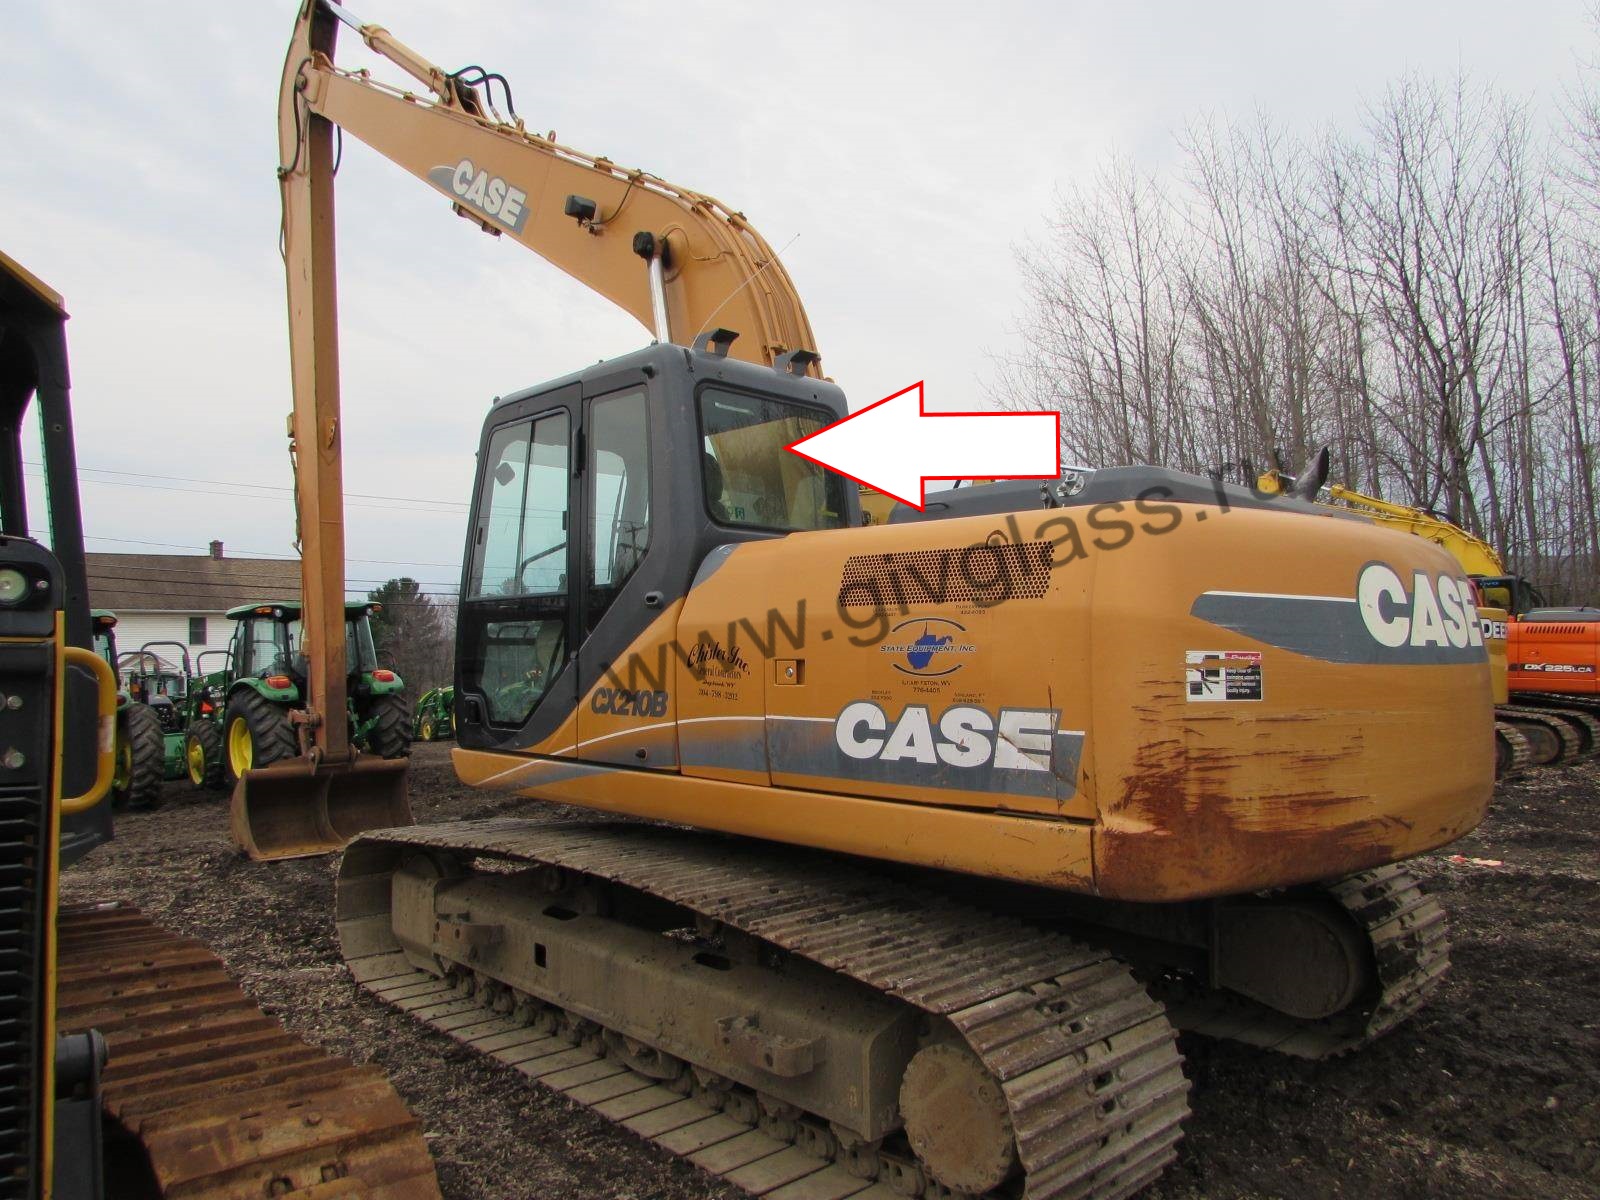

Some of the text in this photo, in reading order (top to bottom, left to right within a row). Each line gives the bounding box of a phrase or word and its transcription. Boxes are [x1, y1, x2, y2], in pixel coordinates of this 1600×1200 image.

[453, 160, 527, 227] CASE
[1358, 565, 1484, 649] CASE
[727, 645, 751, 676] Inc.
[906, 645, 957, 653] EQUIPMENT,
[591, 687, 669, 718] CX210B
[835, 702, 1059, 772] CASE
